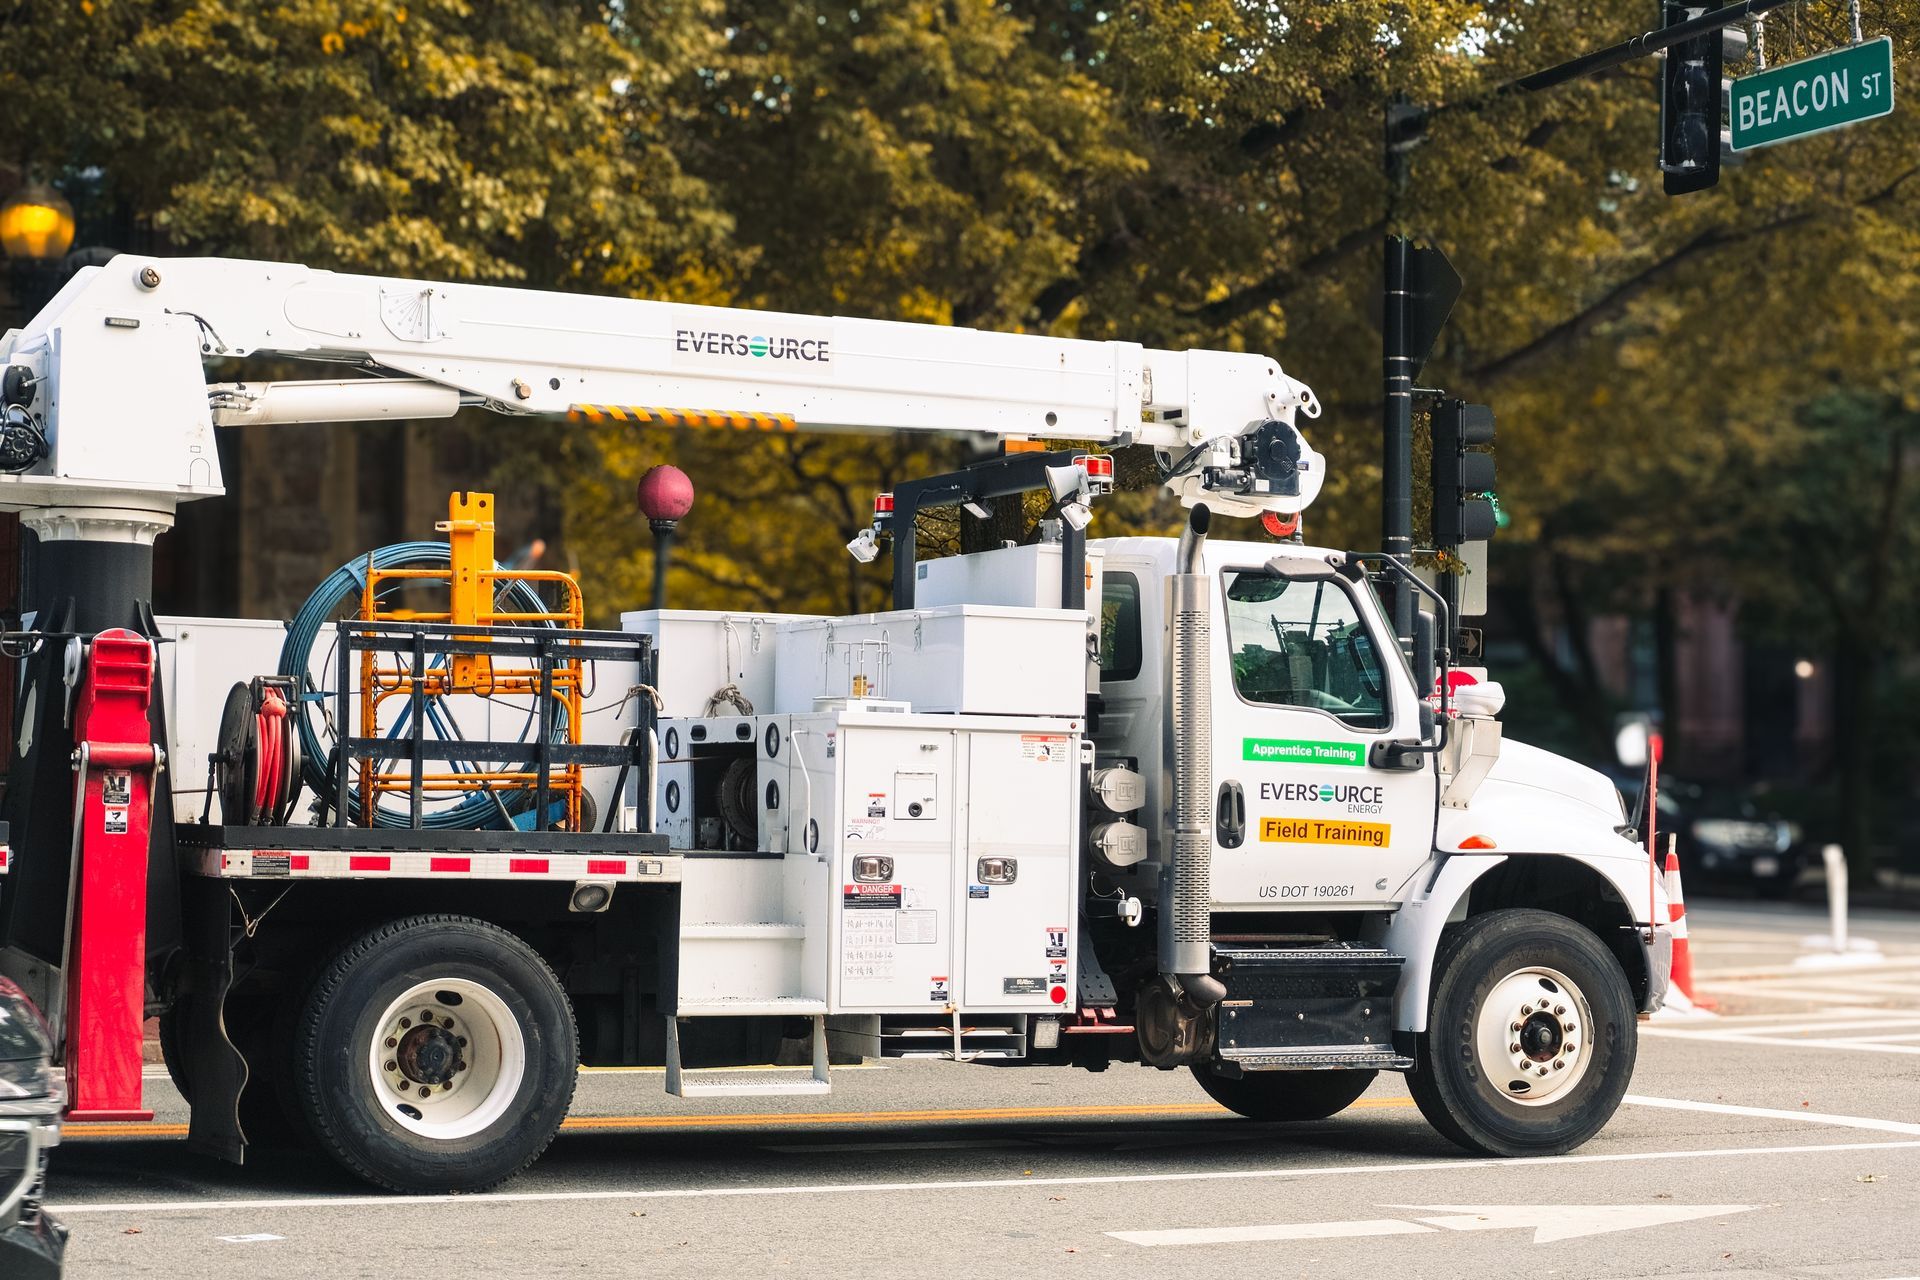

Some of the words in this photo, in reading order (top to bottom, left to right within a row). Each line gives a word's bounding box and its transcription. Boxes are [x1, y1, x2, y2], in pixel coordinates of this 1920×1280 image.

[1738, 68, 1849, 132] BEACON
[1861, 72, 1882, 100] ST
[676, 329, 830, 362] EVERSOURCE
[1252, 743, 1312, 758] Apprentice
[1313, 746, 1357, 760] Training
[1260, 782, 1383, 804] EVERSOURCE
[1347, 804, 1383, 815] ENERGY
[1266, 821, 1308, 839] Field
[1313, 823, 1384, 847] Training
[861, 885, 895, 894] DANGER
[1259, 886, 1277, 898] US
[1281, 885, 1309, 898] DOT
[1313, 885, 1355, 897] 190261
